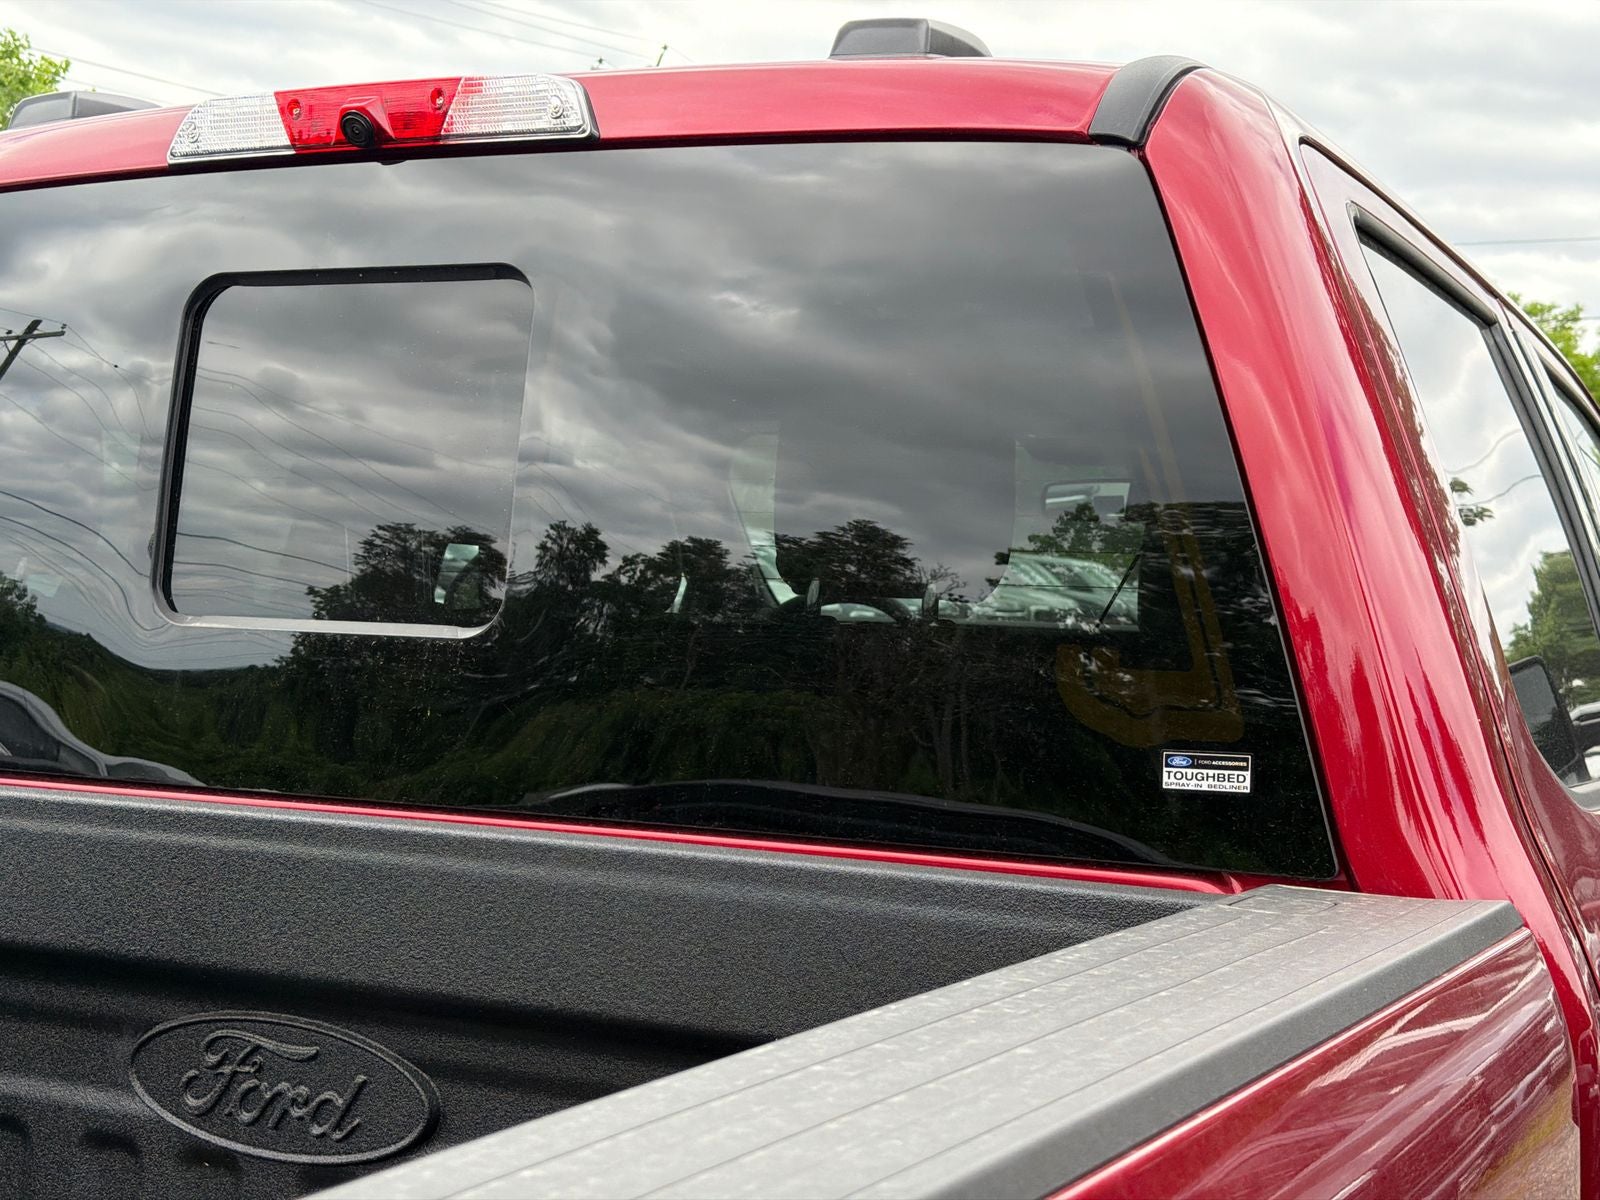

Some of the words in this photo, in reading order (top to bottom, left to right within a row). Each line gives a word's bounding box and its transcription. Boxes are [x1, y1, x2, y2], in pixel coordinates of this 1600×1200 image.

[1165, 770, 1247, 784] TOUGHBED
[1207, 783, 1249, 791] BEDLINER
[178, 1029, 367, 1142] Ford
